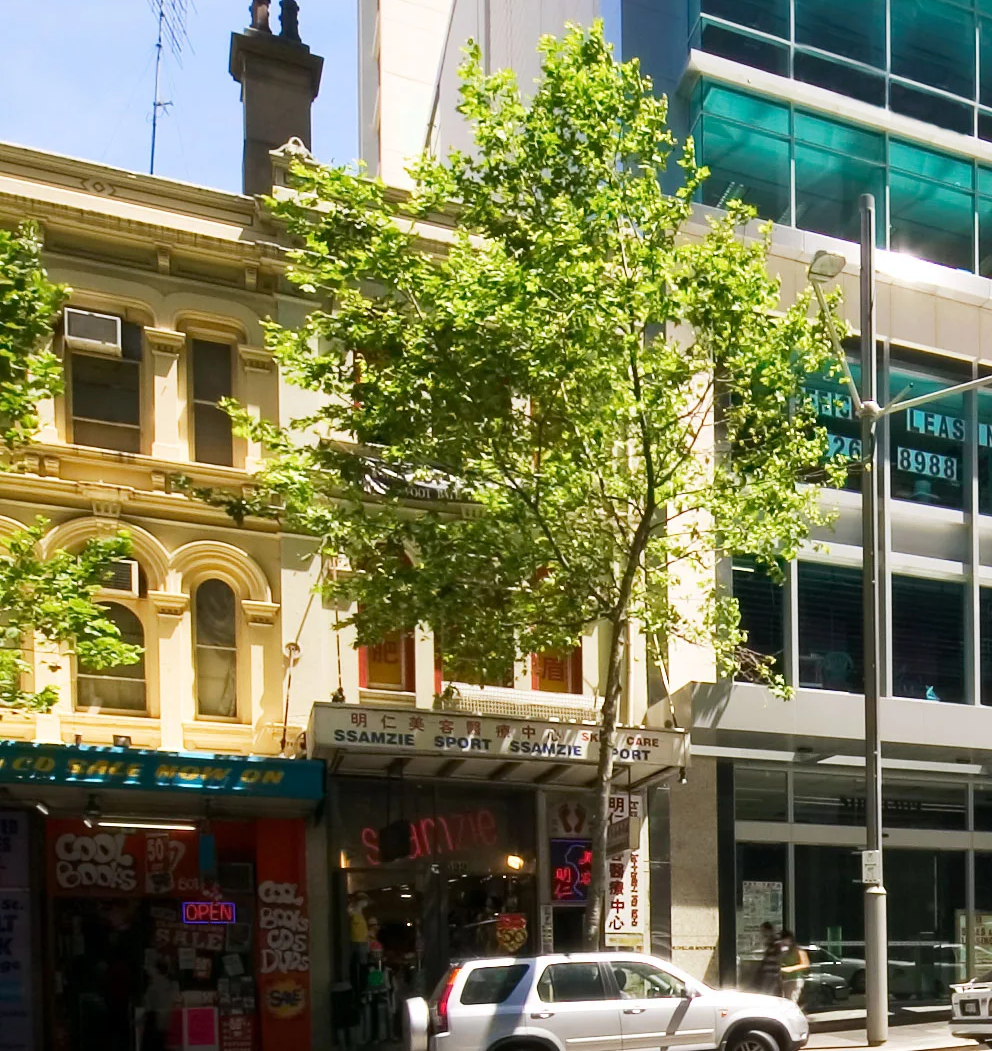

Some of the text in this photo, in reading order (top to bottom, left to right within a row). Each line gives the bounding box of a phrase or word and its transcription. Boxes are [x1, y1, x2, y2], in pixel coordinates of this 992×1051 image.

[900, 450, 956, 478] 8988
[334, 729, 651, 761] SSAMZIE SPORT SSAMZIE PORT
[626, 736, 659, 747] CARE
[12, 757, 285, 784] CD SALE NOW ON
[55, 832, 134, 866] COOL
[186, 904, 232, 920] OPEN
[154, 928, 224, 950] SALE
